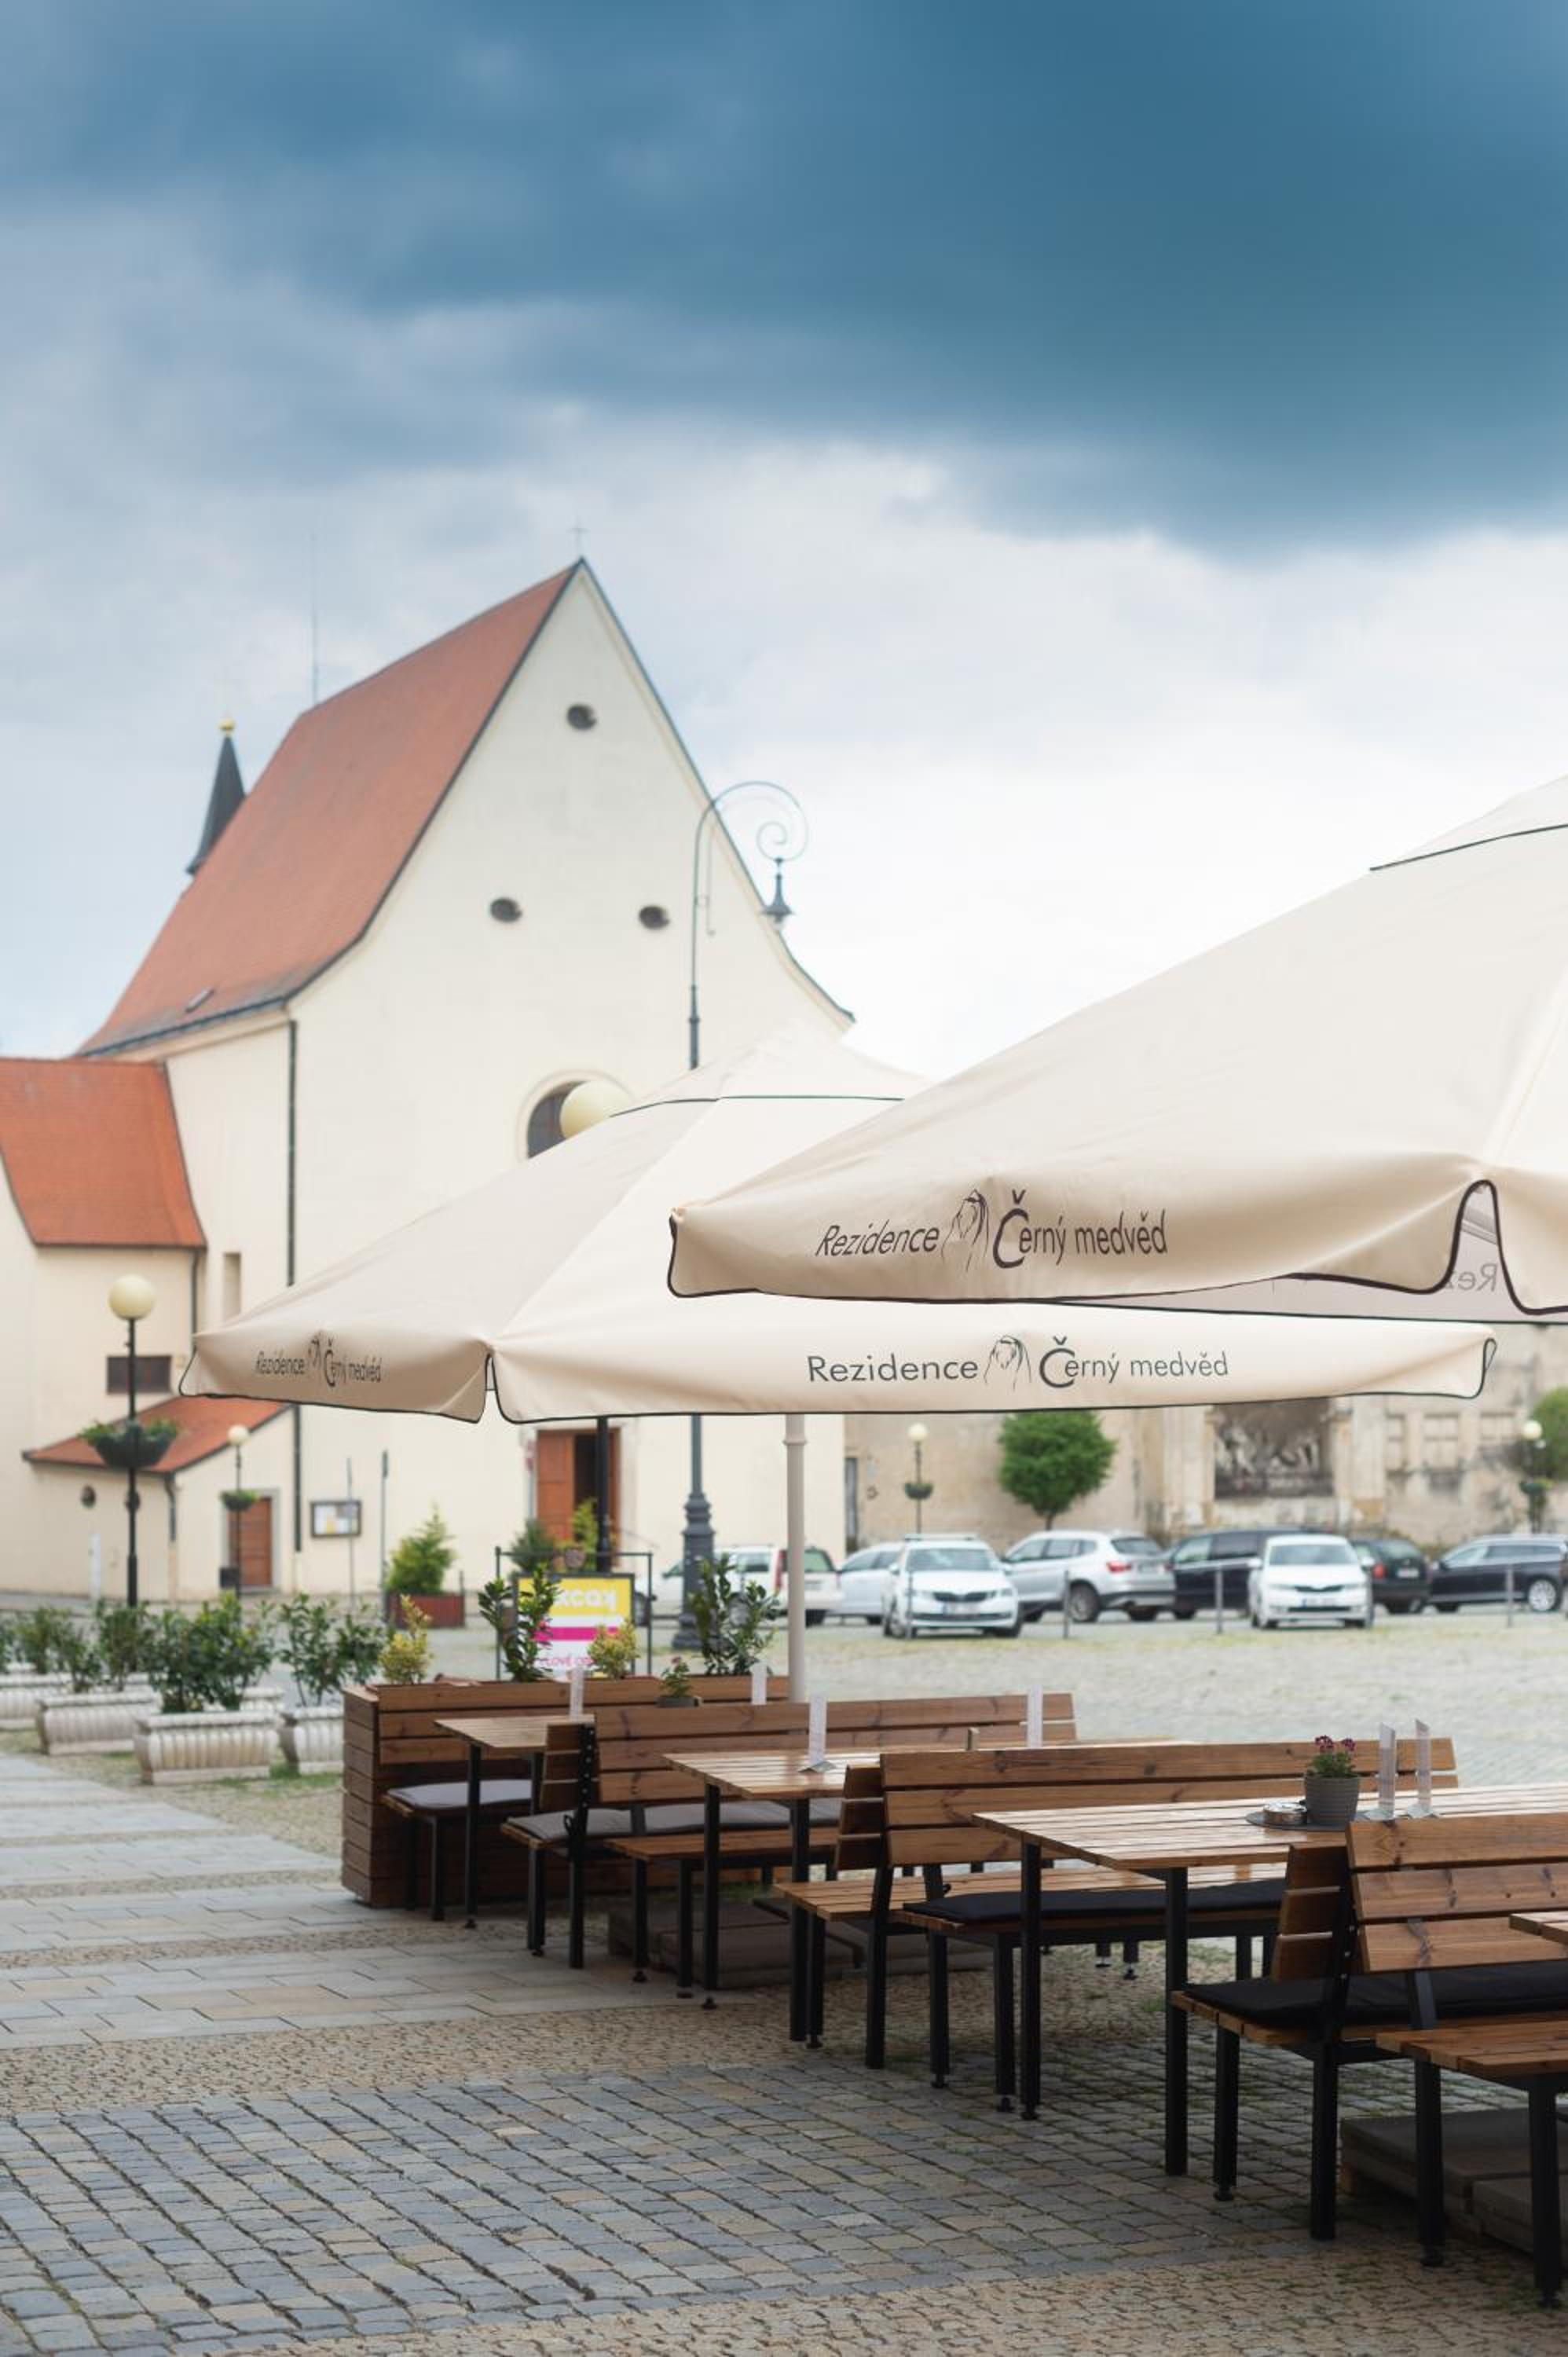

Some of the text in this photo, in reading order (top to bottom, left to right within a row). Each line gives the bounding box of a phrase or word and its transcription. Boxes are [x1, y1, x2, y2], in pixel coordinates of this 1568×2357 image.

[815, 1189, 1168, 1269] Rezidence Černý medvěd
[255, 1349, 306, 1375] Rezidence
[807, 1336, 1229, 1388] Rezidence Černý medvěd
